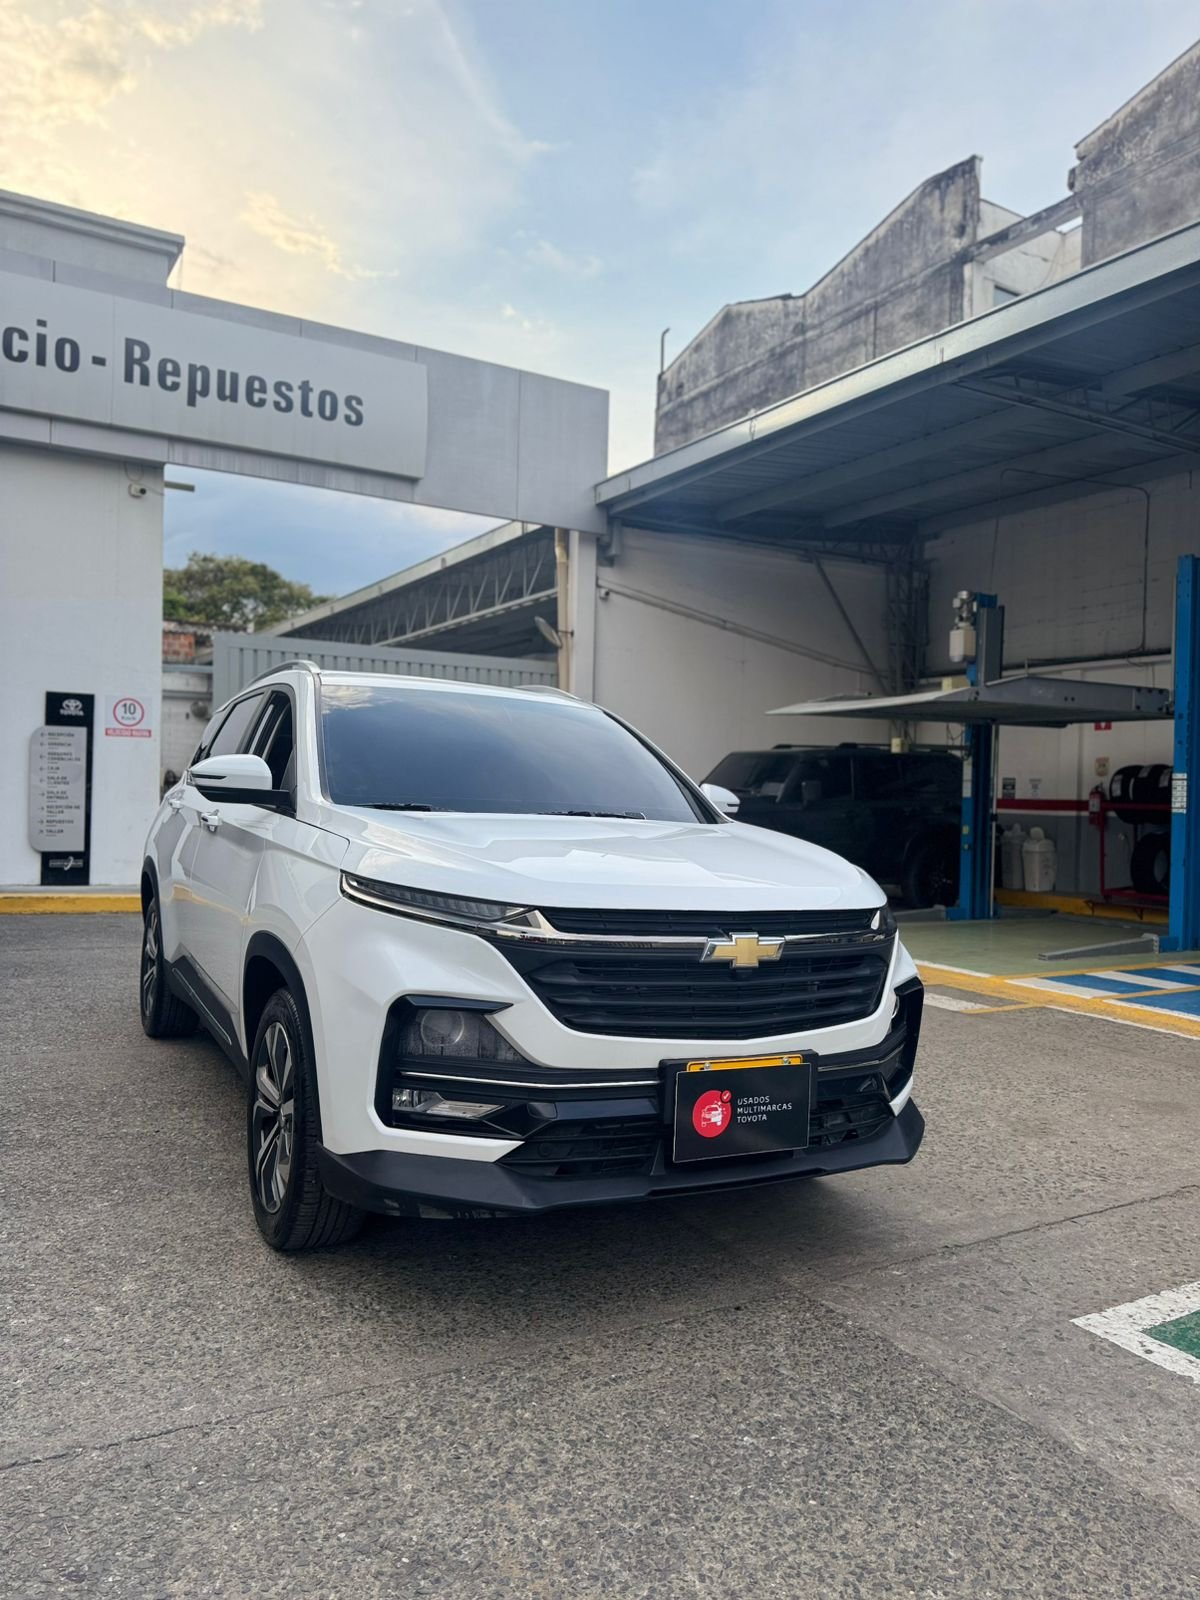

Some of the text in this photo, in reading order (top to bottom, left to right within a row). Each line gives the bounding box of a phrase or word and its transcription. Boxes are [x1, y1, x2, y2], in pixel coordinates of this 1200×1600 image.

[123, 337, 365, 427] Repuestos
[122, 702, 137, 715] 10
[737, 1096, 770, 1106] USADOS
[737, 1102, 793, 1114] MULTIMARCAS
[737, 1114, 768, 1123] TOYOTA
